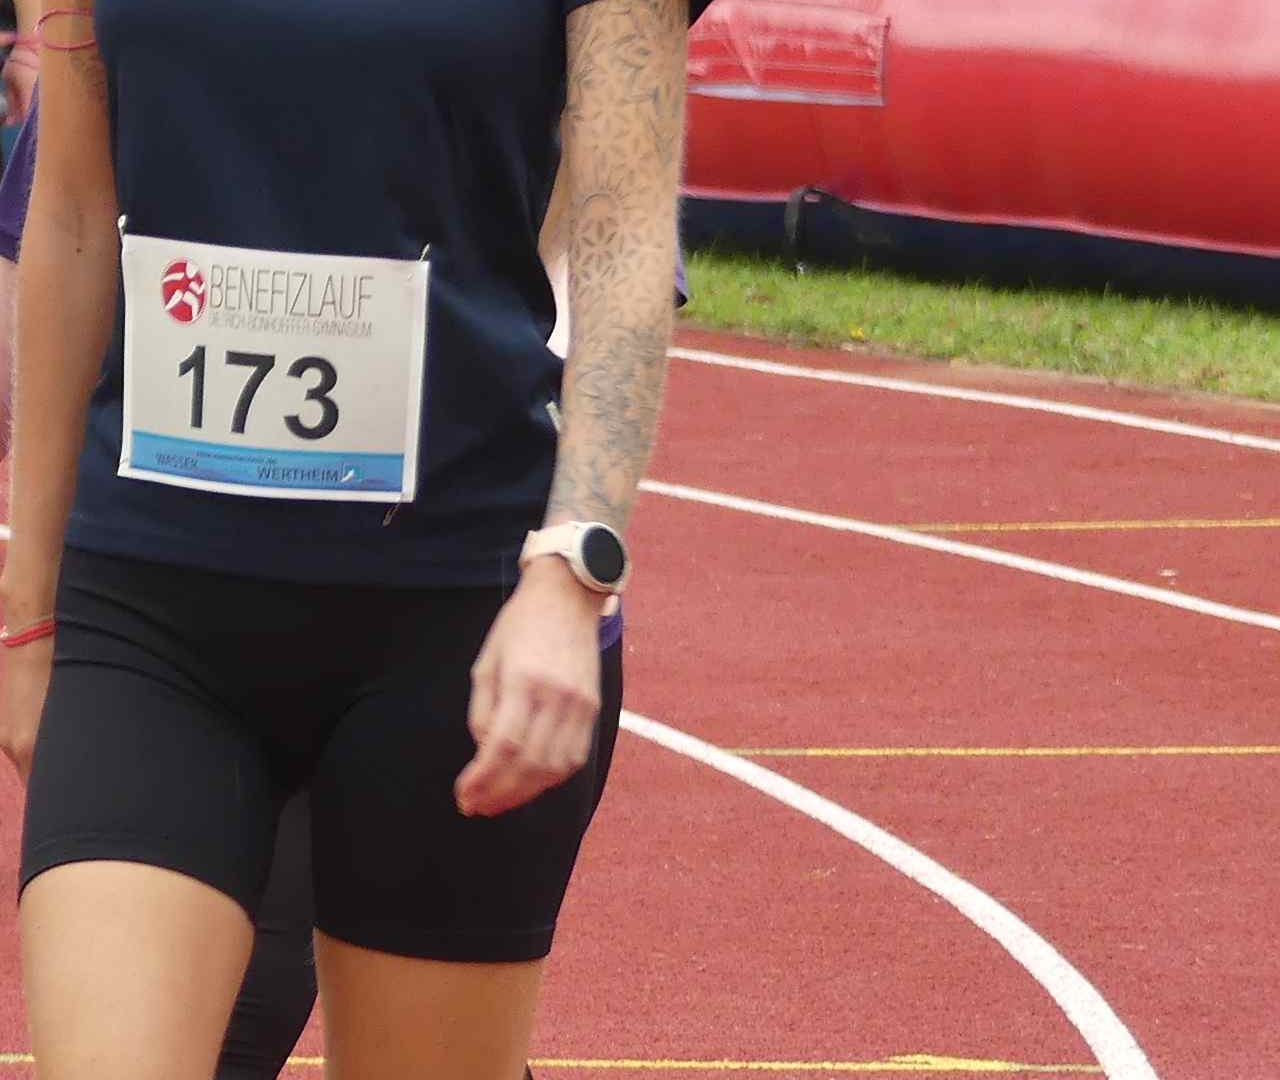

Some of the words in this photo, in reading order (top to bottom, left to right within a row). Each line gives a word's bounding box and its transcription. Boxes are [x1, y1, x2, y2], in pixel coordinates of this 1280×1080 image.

[208, 264, 375, 321] BENEFIZLAUF
[178, 345, 341, 441] 173
[256, 465, 340, 483] WERTHEIM
